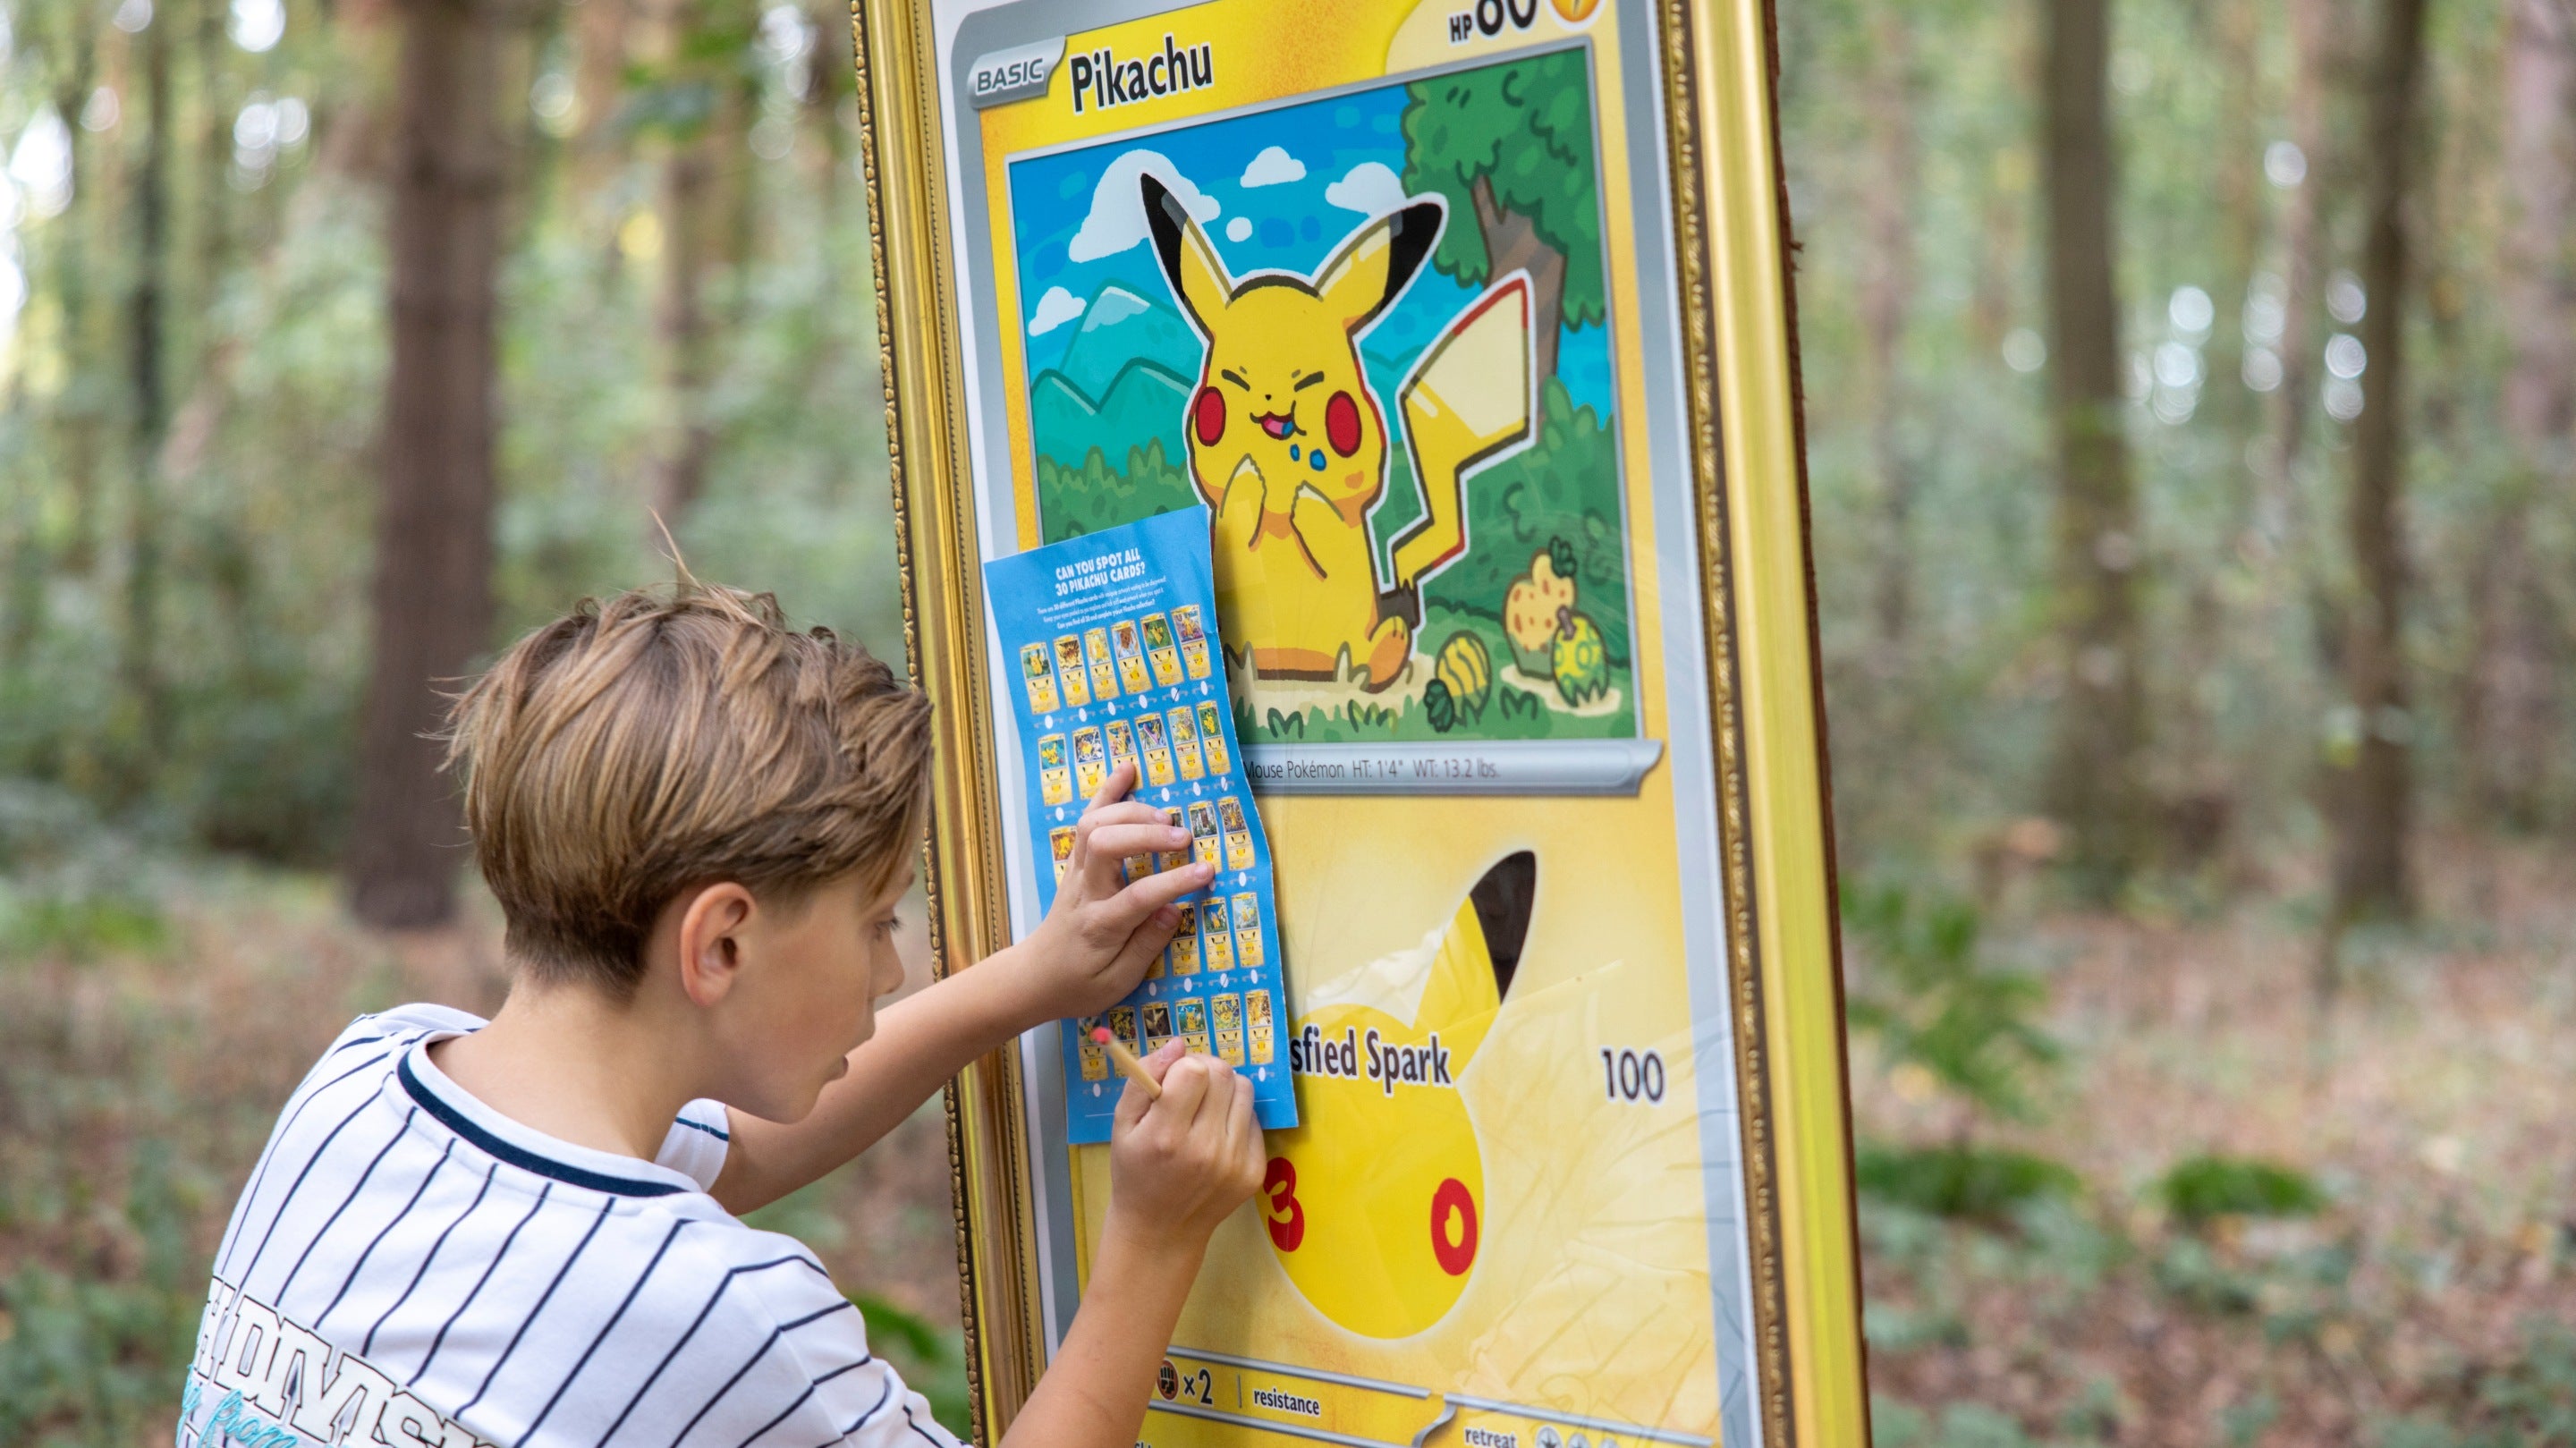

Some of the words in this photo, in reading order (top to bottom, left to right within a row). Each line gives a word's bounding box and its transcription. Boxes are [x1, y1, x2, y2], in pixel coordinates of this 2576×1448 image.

[1449, 13, 1472, 42] HP
[977, 57, 1044, 93] BASIC
[1071, 35, 1213, 113] Pikachu
[1055, 564, 1075, 580] CAN
[1074, 558, 1094, 575] YOU
[1096, 552, 1123, 571] SPOT
[1124, 547, 1141, 563] ALL
[1055, 581, 1069, 597] 30
[1069, 571, 1108, 593] PIKACHU
[1110, 561, 1146, 582] CARDS?
[1243, 760, 1284, 779] Mouse
[1287, 759, 1344, 779] Pokémon
[1352, 760, 1372, 779] HT:
[1412, 759, 1438, 779] WT:
[1444, 758, 1472, 779] 13.2
[1365, 1028, 1452, 1094] Spark
[1601, 1048, 1665, 1103] 100
[1254, 1388, 1320, 1415] resistance
[1464, 1428, 1517, 1448] retreat
